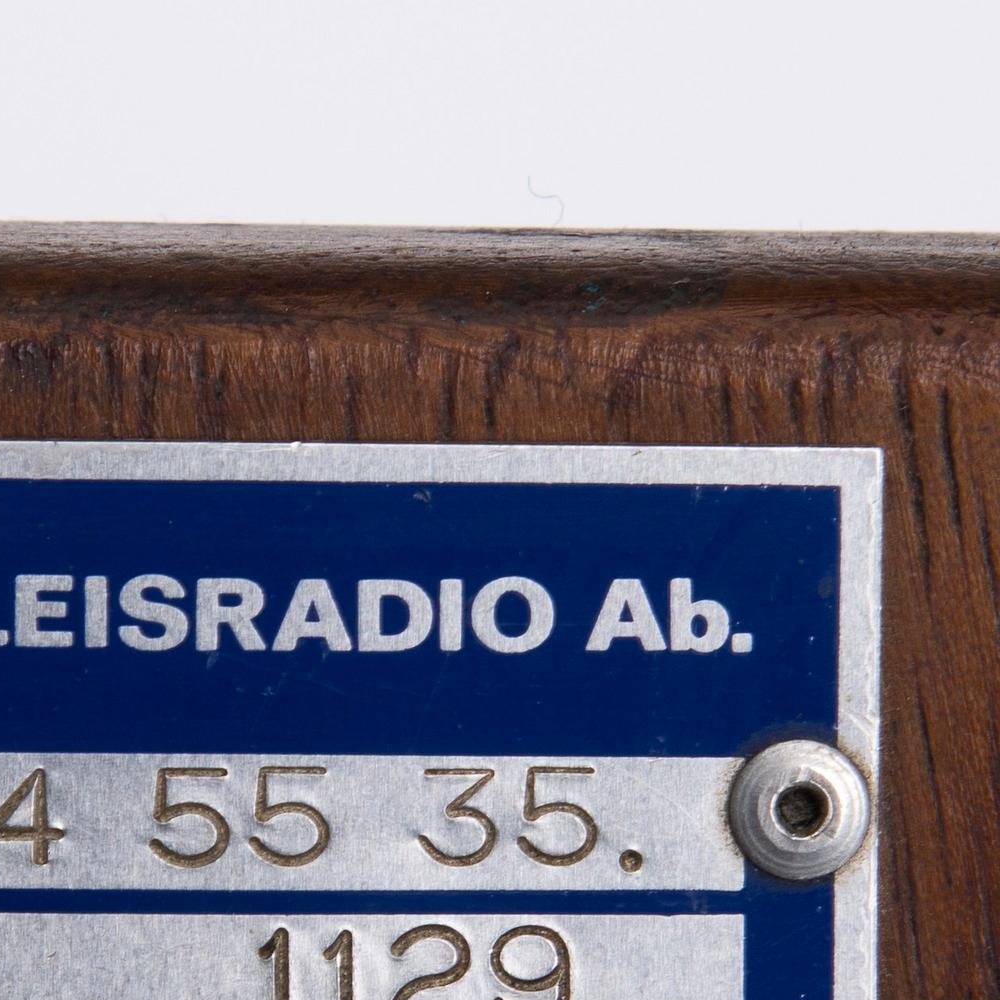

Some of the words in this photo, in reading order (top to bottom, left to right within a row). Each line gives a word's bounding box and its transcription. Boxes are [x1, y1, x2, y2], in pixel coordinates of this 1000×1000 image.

[585, 577, 754, 654] Ab.
[148, 766, 331, 868] 55
[417, 765, 644, 874] 35.
